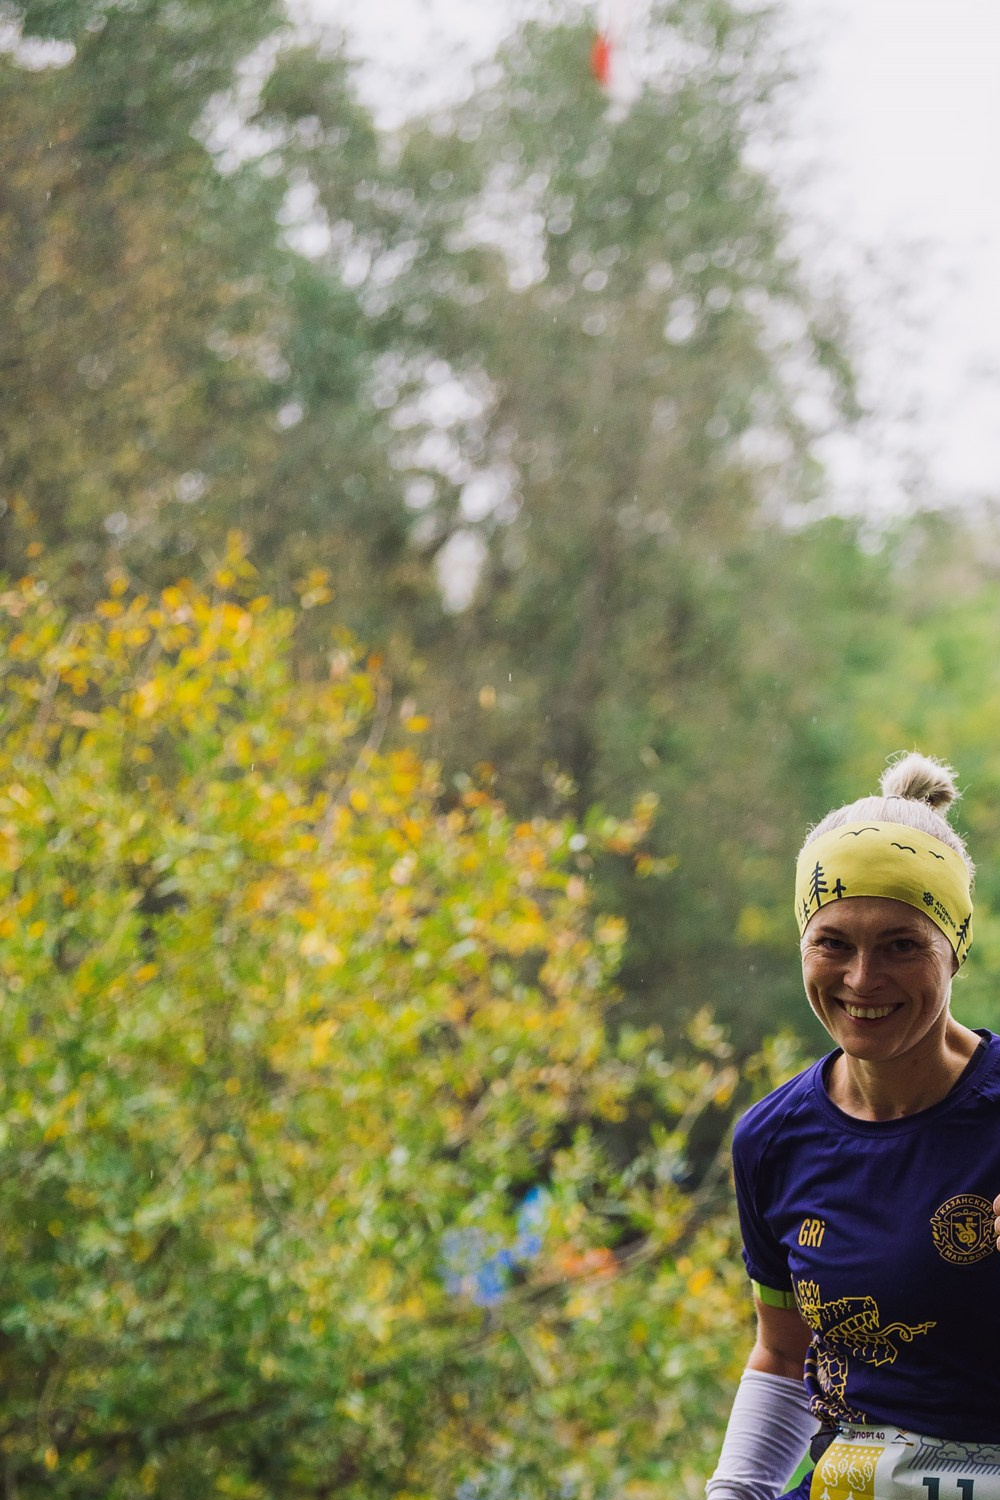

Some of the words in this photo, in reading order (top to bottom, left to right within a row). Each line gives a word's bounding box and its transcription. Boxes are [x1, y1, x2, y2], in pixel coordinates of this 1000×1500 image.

[940, 1197, 993, 1215] КАЗАНСКИЙ
[944, 1249, 988, 1262] МАРАФОН
[876, 1432, 885, 1440] 40
